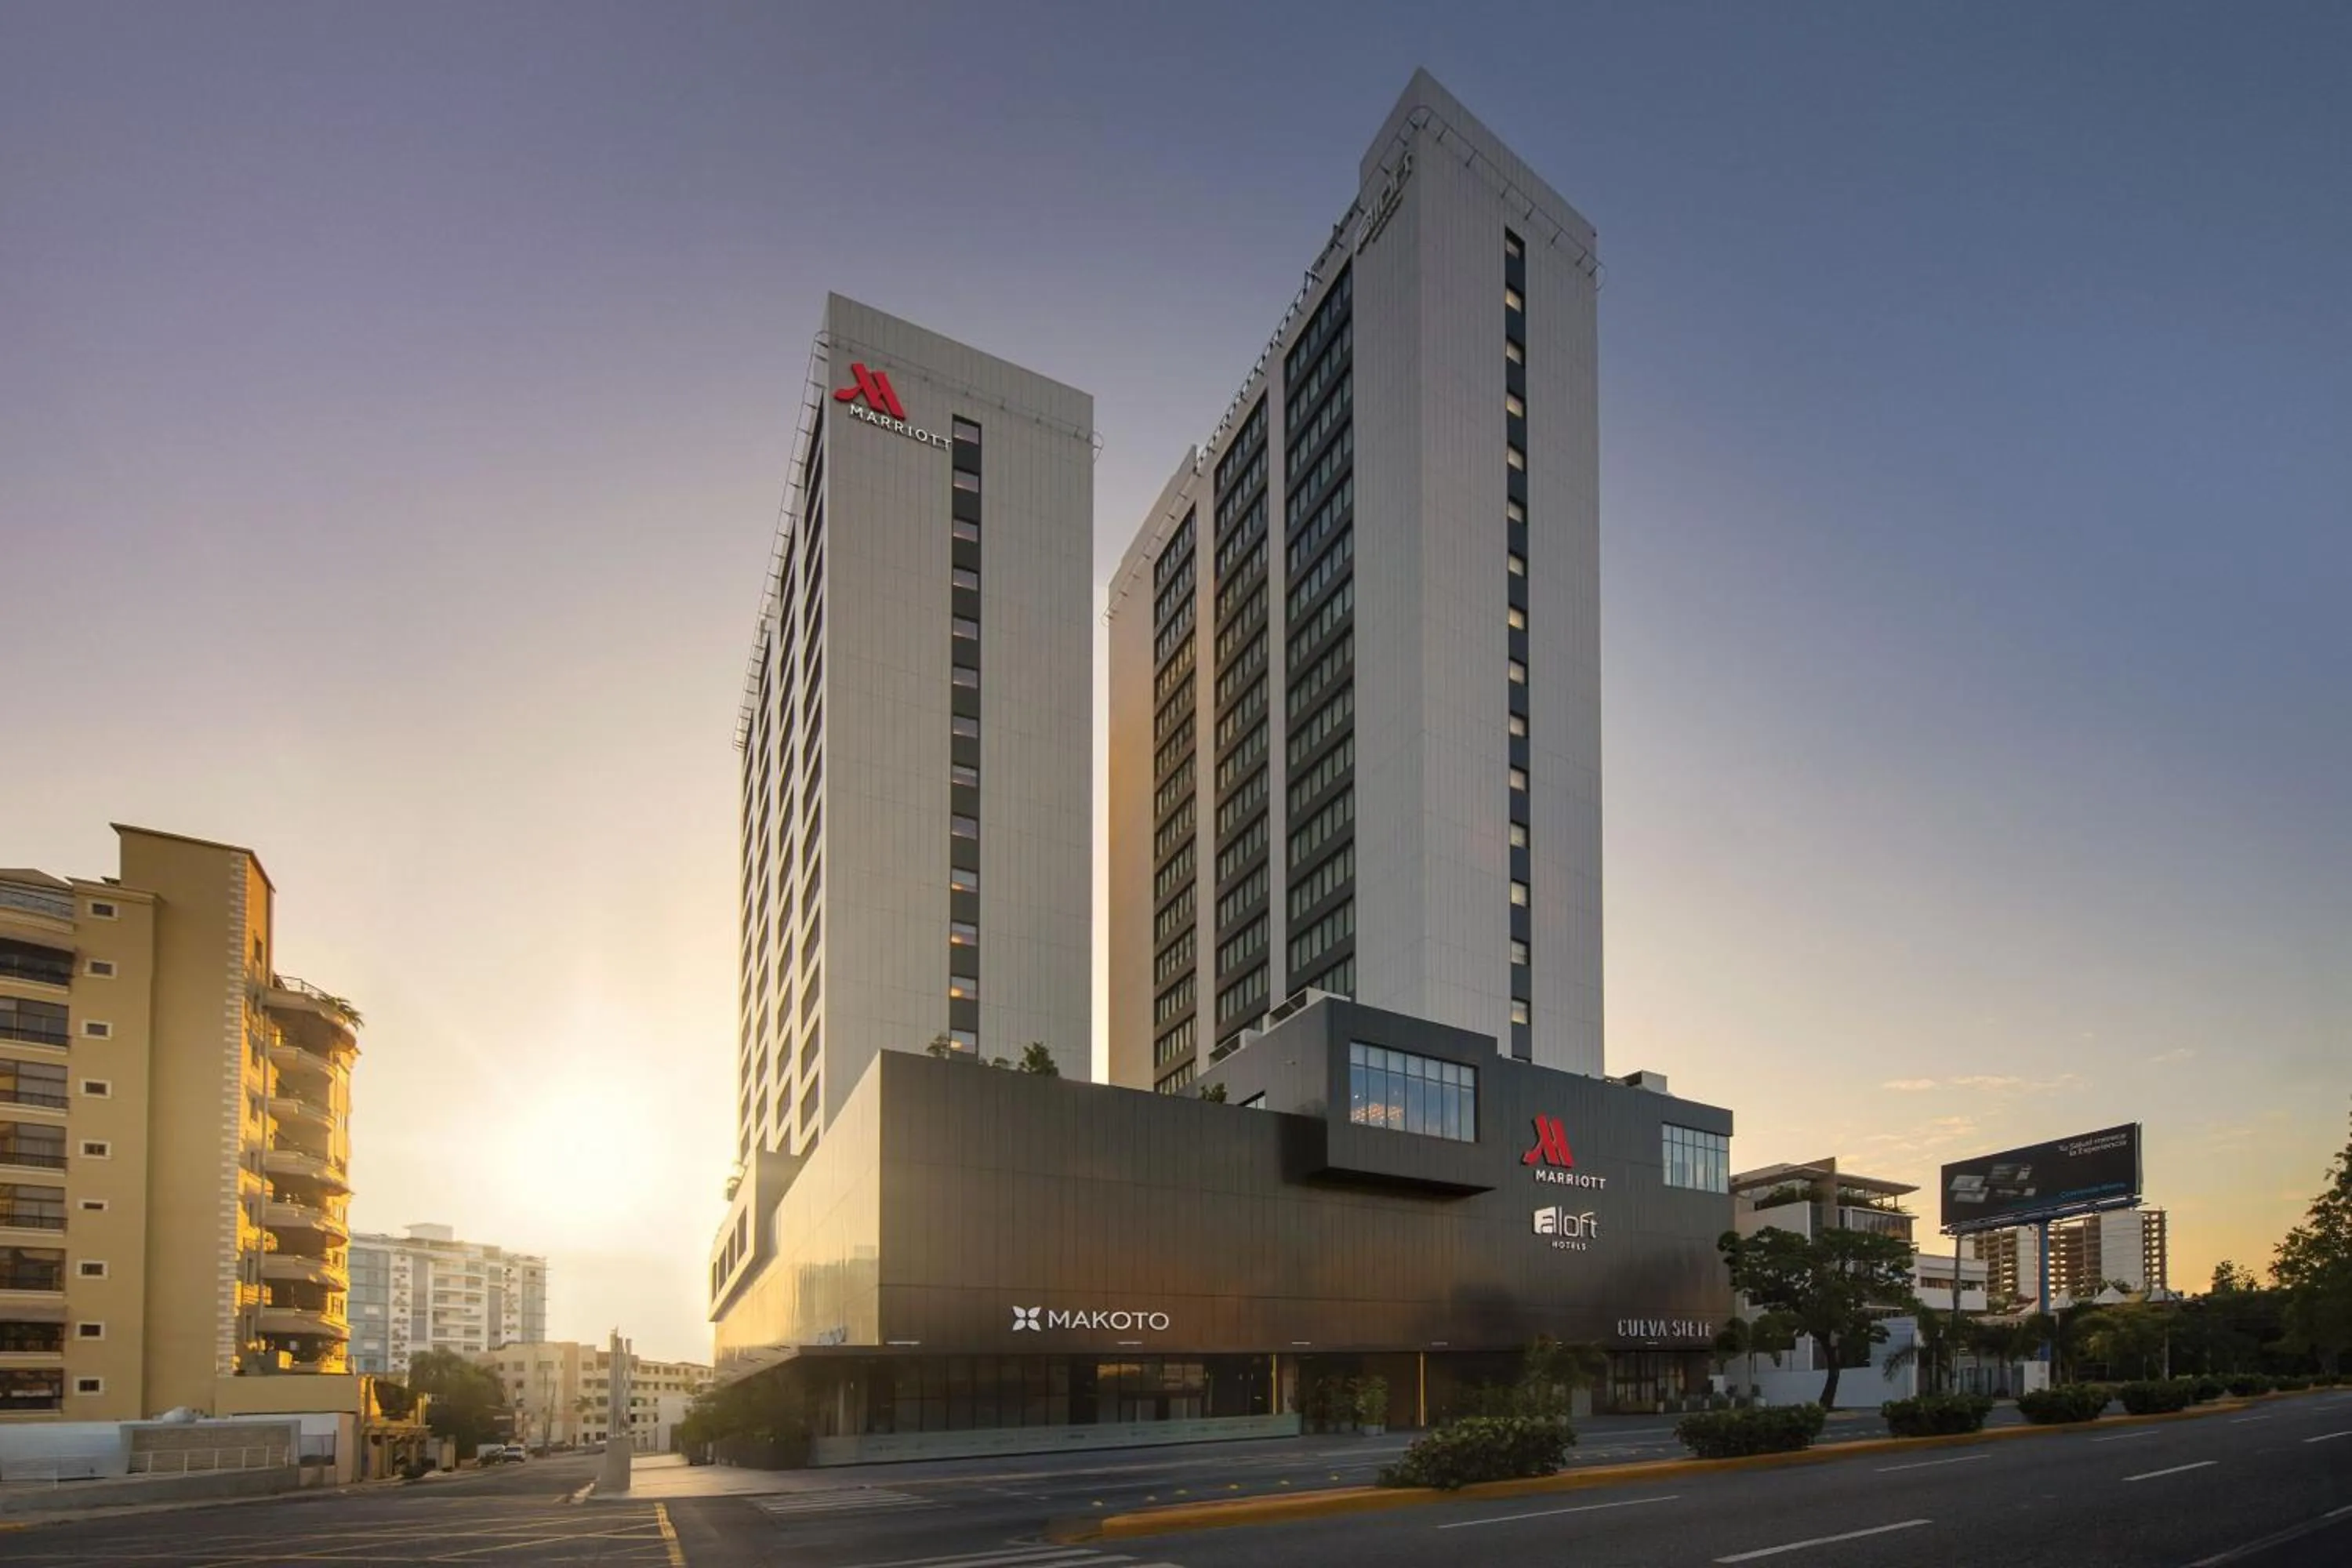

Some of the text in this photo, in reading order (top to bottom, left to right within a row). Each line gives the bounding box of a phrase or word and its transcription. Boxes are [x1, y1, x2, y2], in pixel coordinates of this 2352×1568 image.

[850, 404, 953, 452] MARRIOTT
[1536, 1170, 1606, 1189] MARRIOTT
[1534, 1206, 1598, 1239] aloft
[1552, 1241, 1587, 1251] HOTELS
[1047, 1309, 1170, 1330] MAKOTO
[1617, 1318, 1668, 1337] CUEVA
